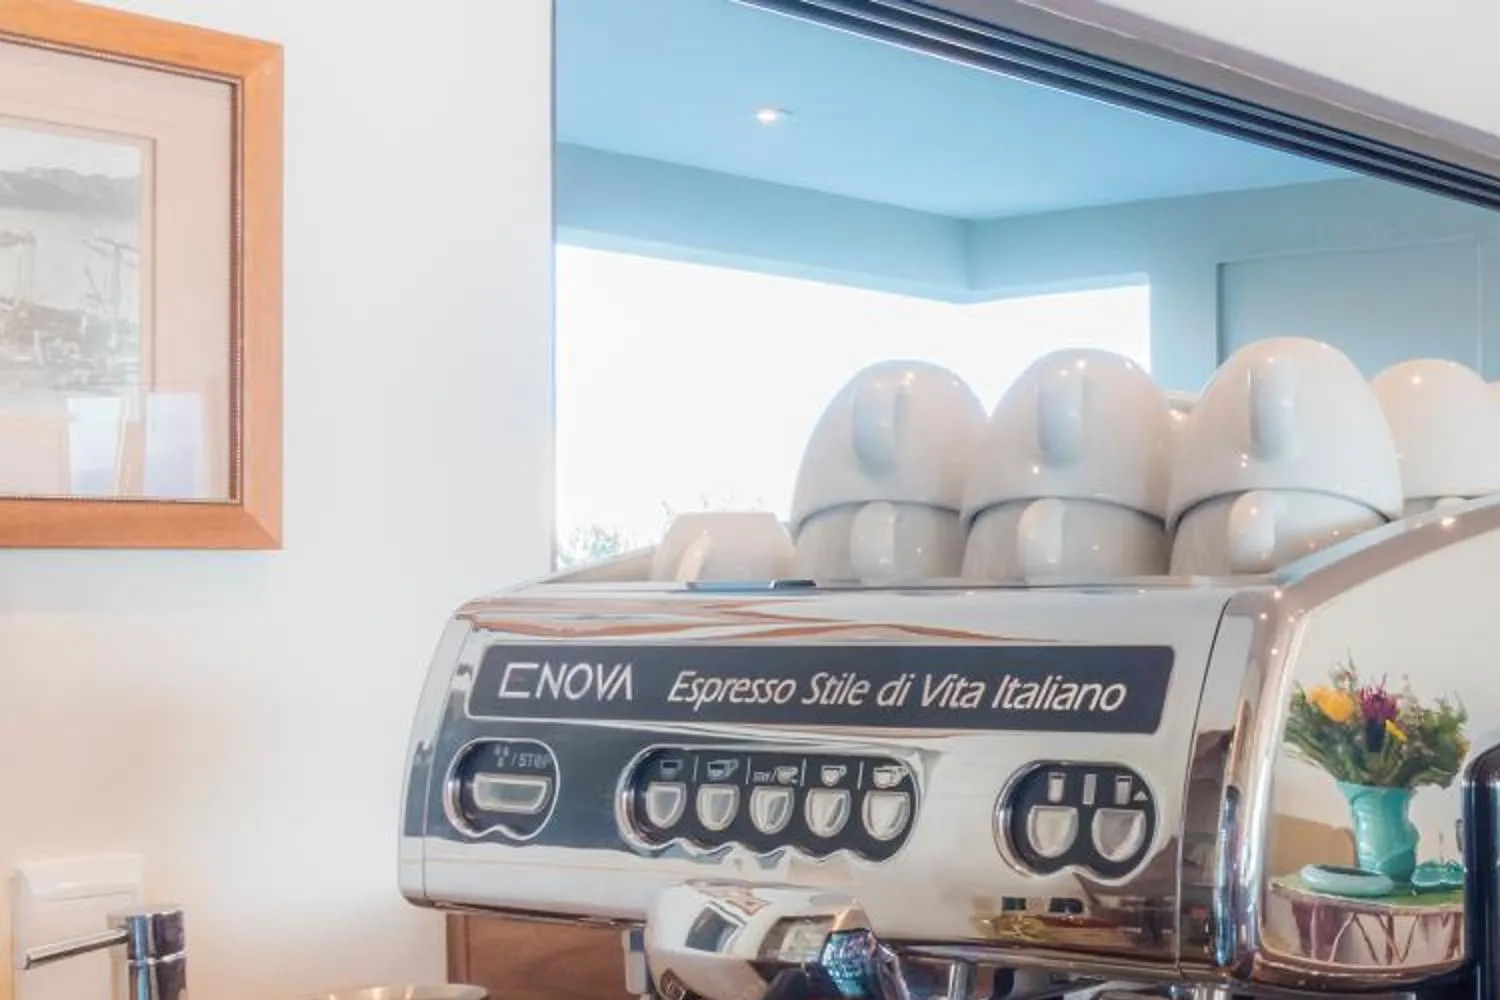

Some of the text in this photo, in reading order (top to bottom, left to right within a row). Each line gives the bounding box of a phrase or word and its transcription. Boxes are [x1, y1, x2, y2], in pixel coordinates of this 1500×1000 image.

[498, 661, 1127, 712] ENOVA Espresso Stile di Vita Italiano
